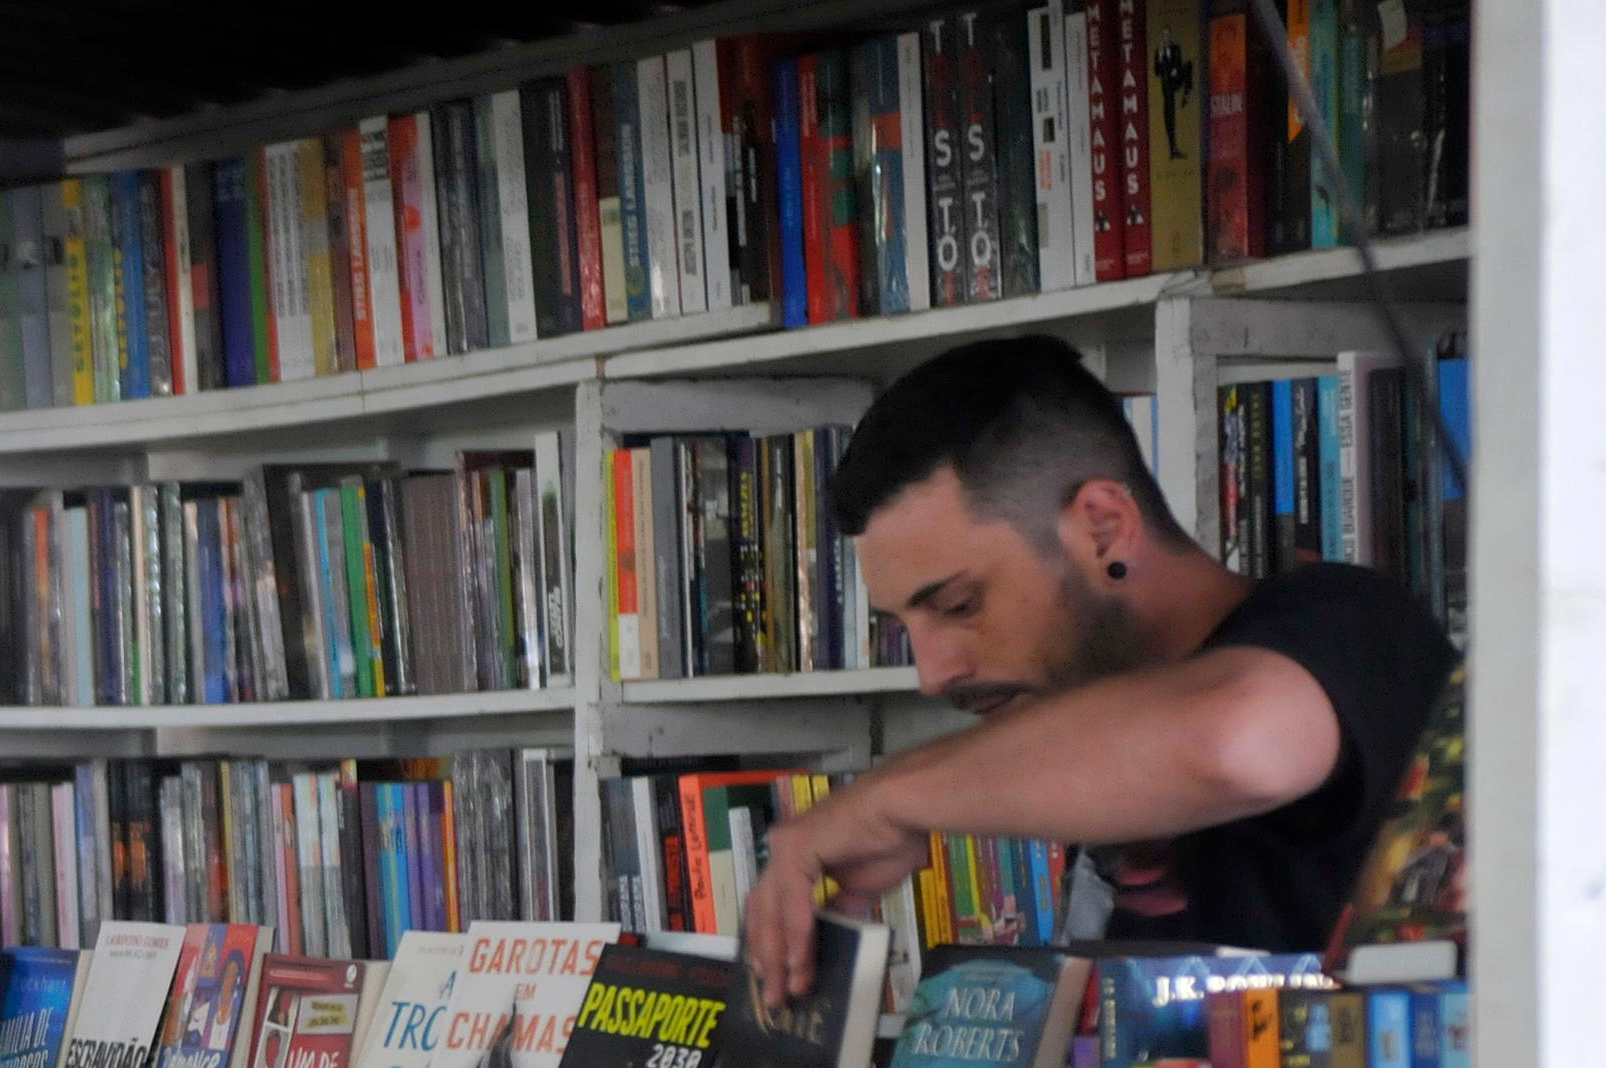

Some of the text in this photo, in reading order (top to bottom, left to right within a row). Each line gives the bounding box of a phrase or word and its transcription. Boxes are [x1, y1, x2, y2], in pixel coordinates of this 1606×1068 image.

[468, 938, 604, 977] GAROTAS
[577, 982, 726, 1048] PASSAPORTE
[945, 987, 1015, 1021] NORA
[447, 1012, 578, 1054] CHAMAS
[914, 1023, 1025, 1063] ROBERTS
